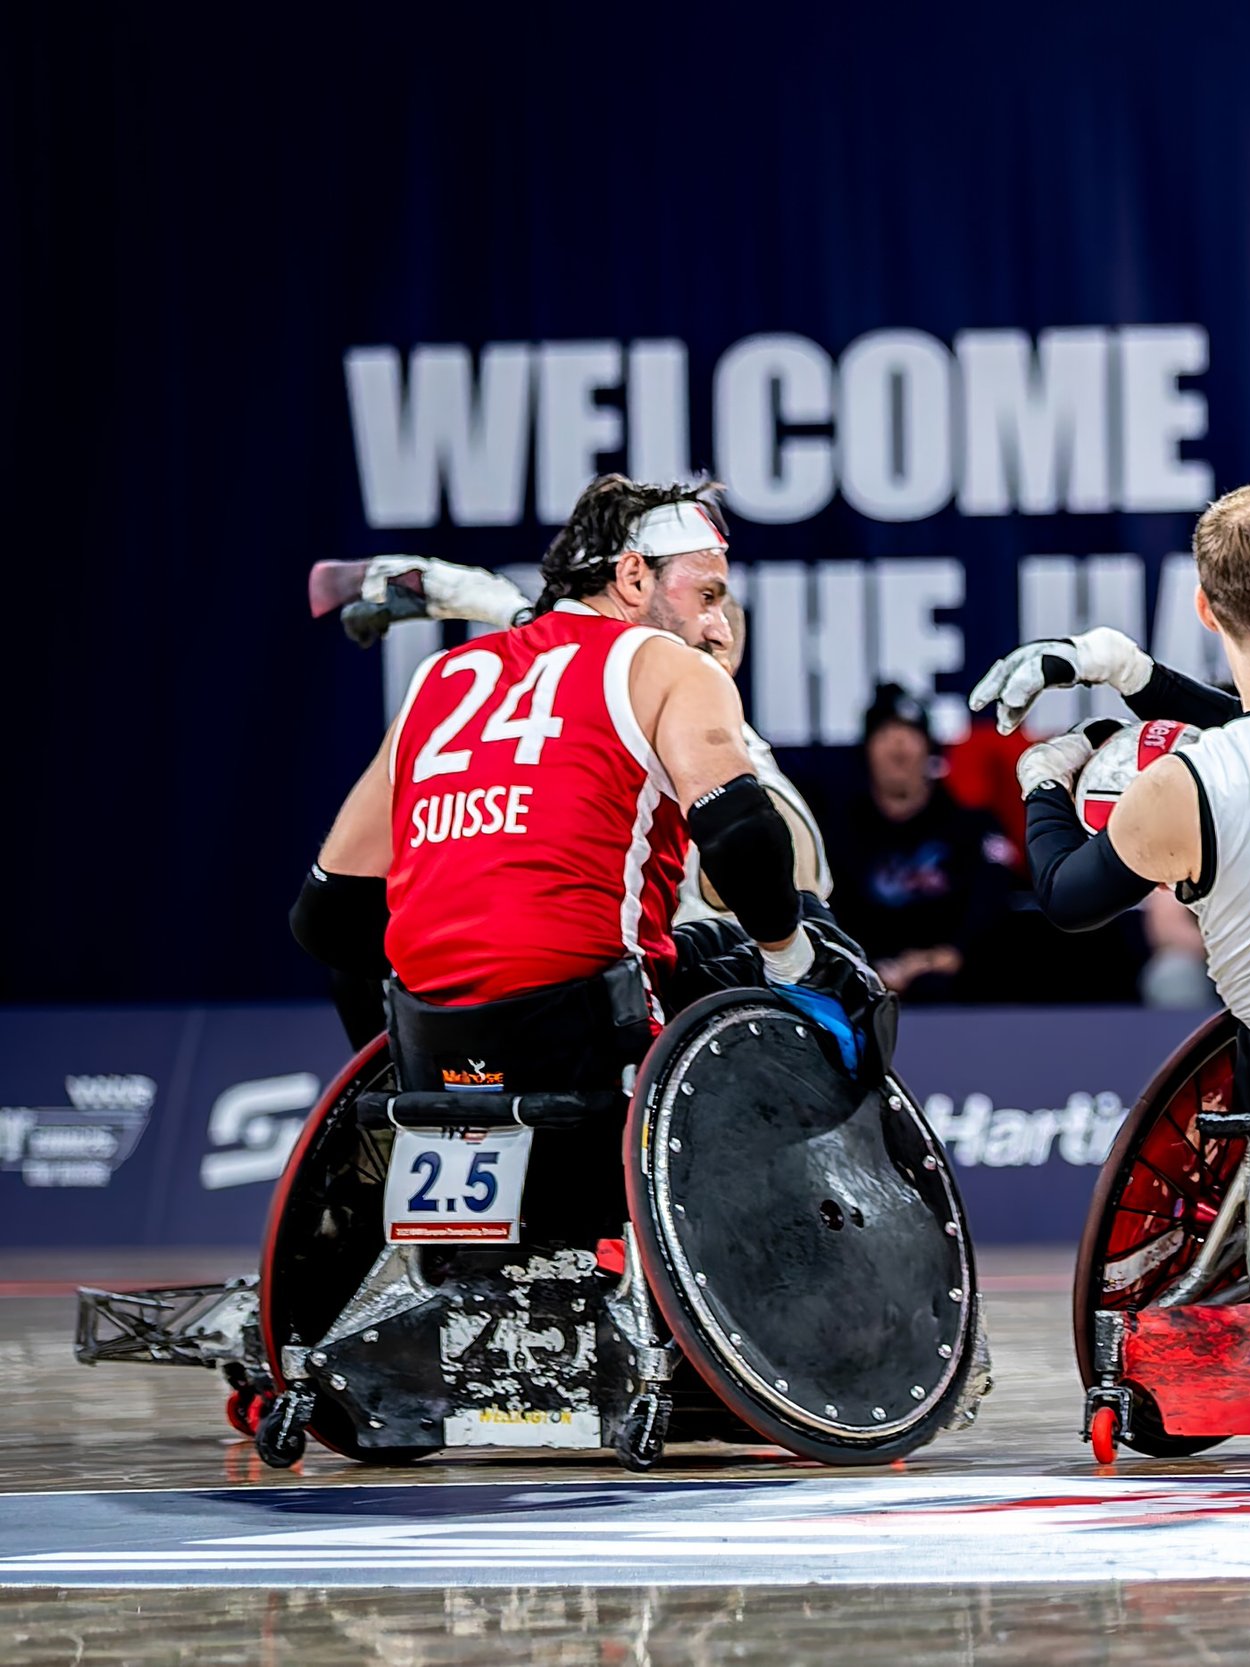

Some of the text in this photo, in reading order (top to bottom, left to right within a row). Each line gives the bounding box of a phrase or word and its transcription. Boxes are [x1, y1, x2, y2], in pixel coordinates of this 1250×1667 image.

[345, 325, 1215, 530] WELCOME
[733, 555, 967, 749] HE
[411, 642, 582, 783] 24
[410, 785, 534, 848] SUISSE
[407, 1150, 500, 1213] 2.5
[924, 1090, 1131, 1167] Harti
